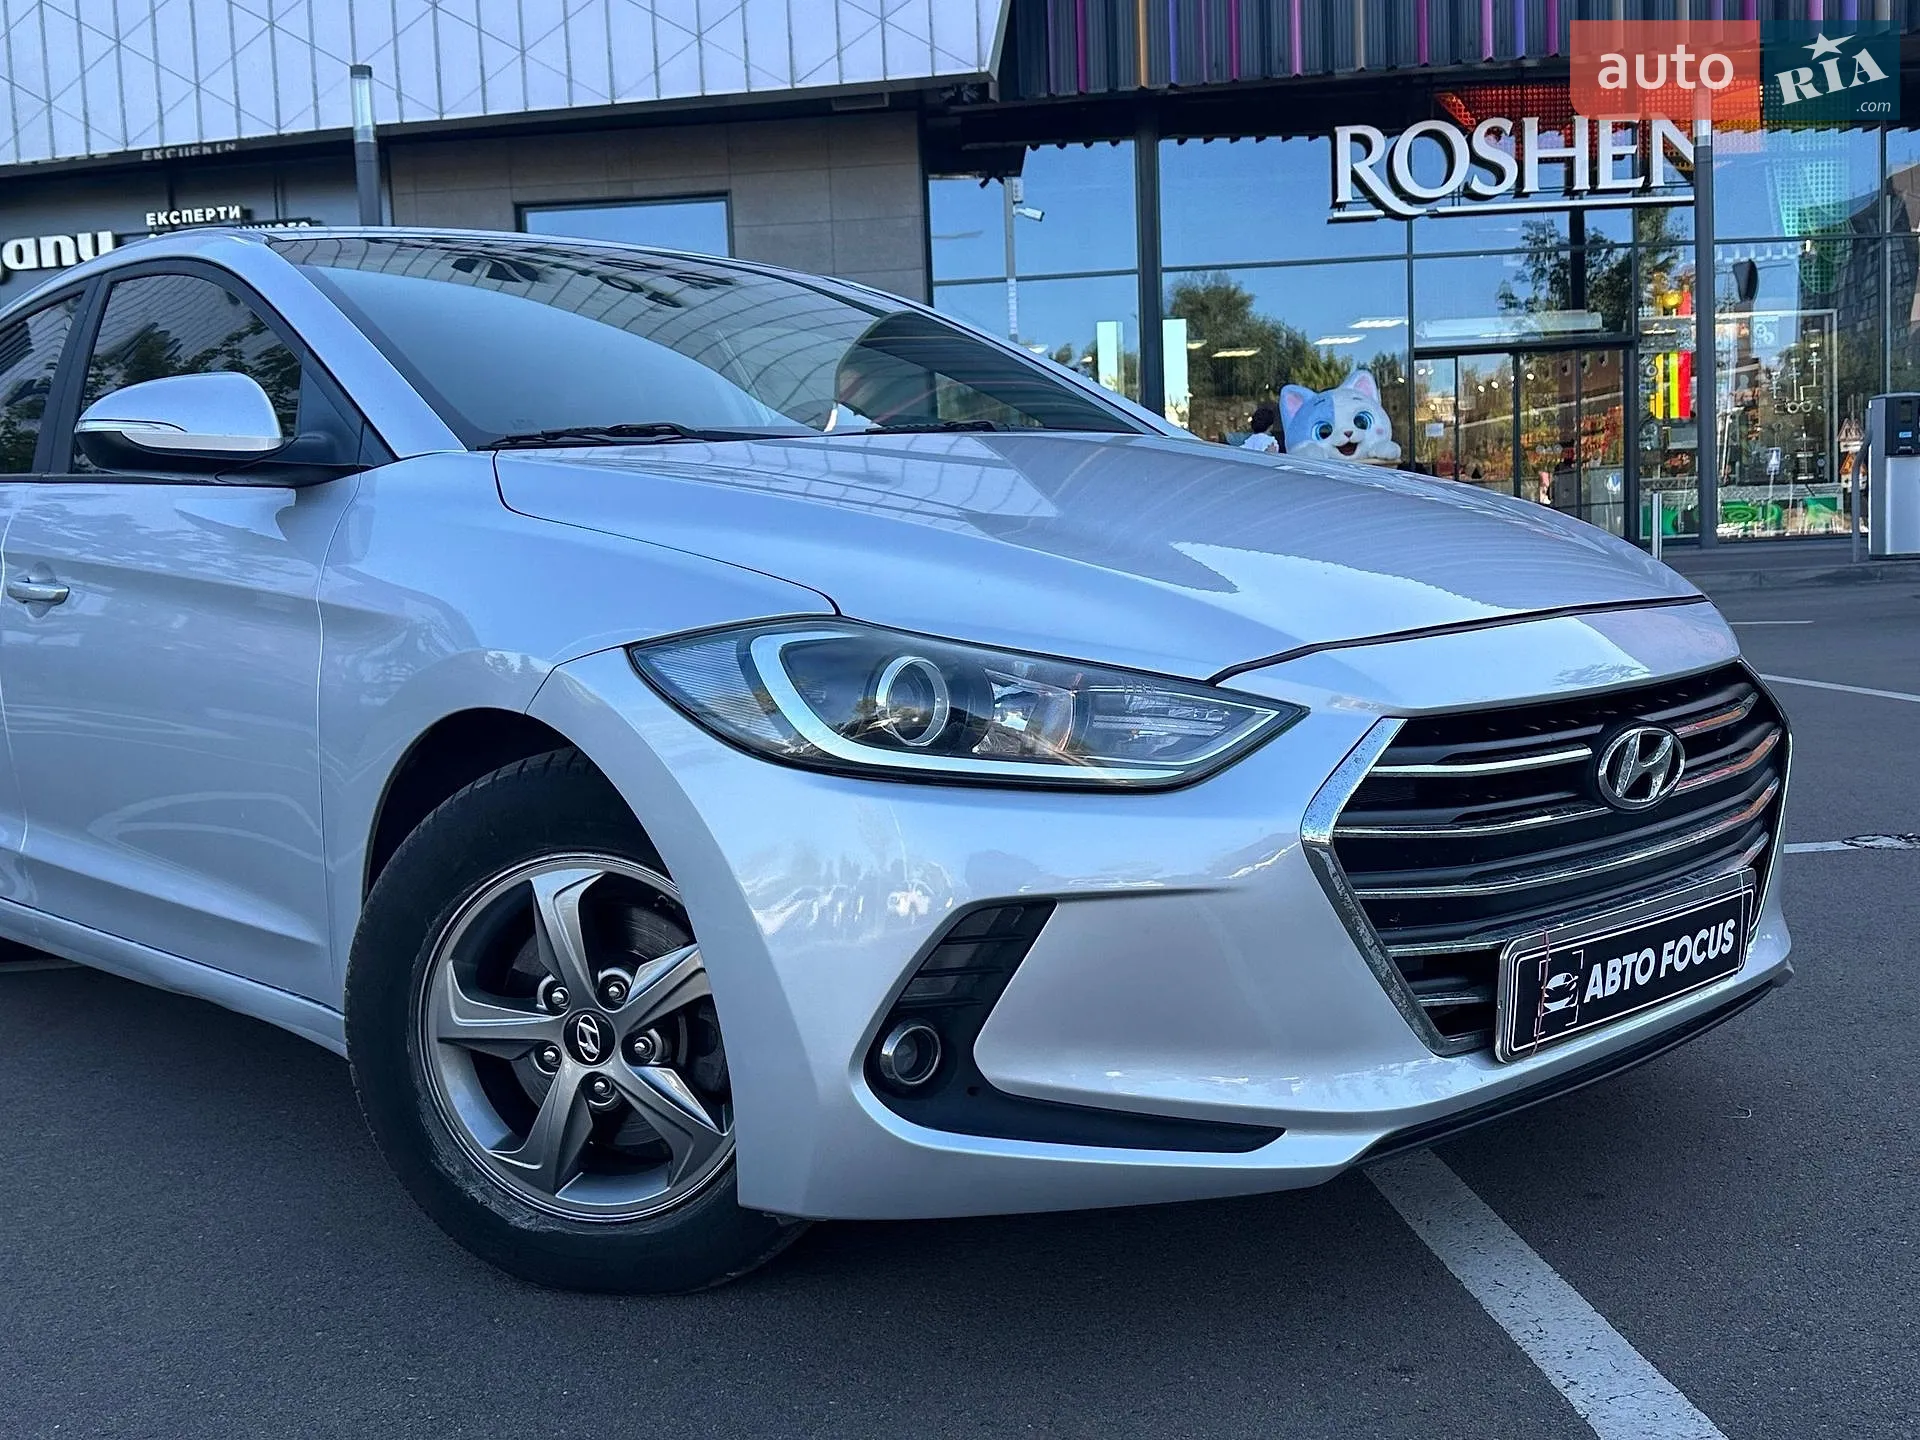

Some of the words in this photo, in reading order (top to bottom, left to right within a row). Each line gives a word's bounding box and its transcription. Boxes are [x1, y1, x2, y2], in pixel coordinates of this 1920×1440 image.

[1335, 112, 1695, 215] ROSHEN
[145, 205, 241, 226] ЕКСПЕРТИ
[1659, 918, 1736, 978] FOCUS
